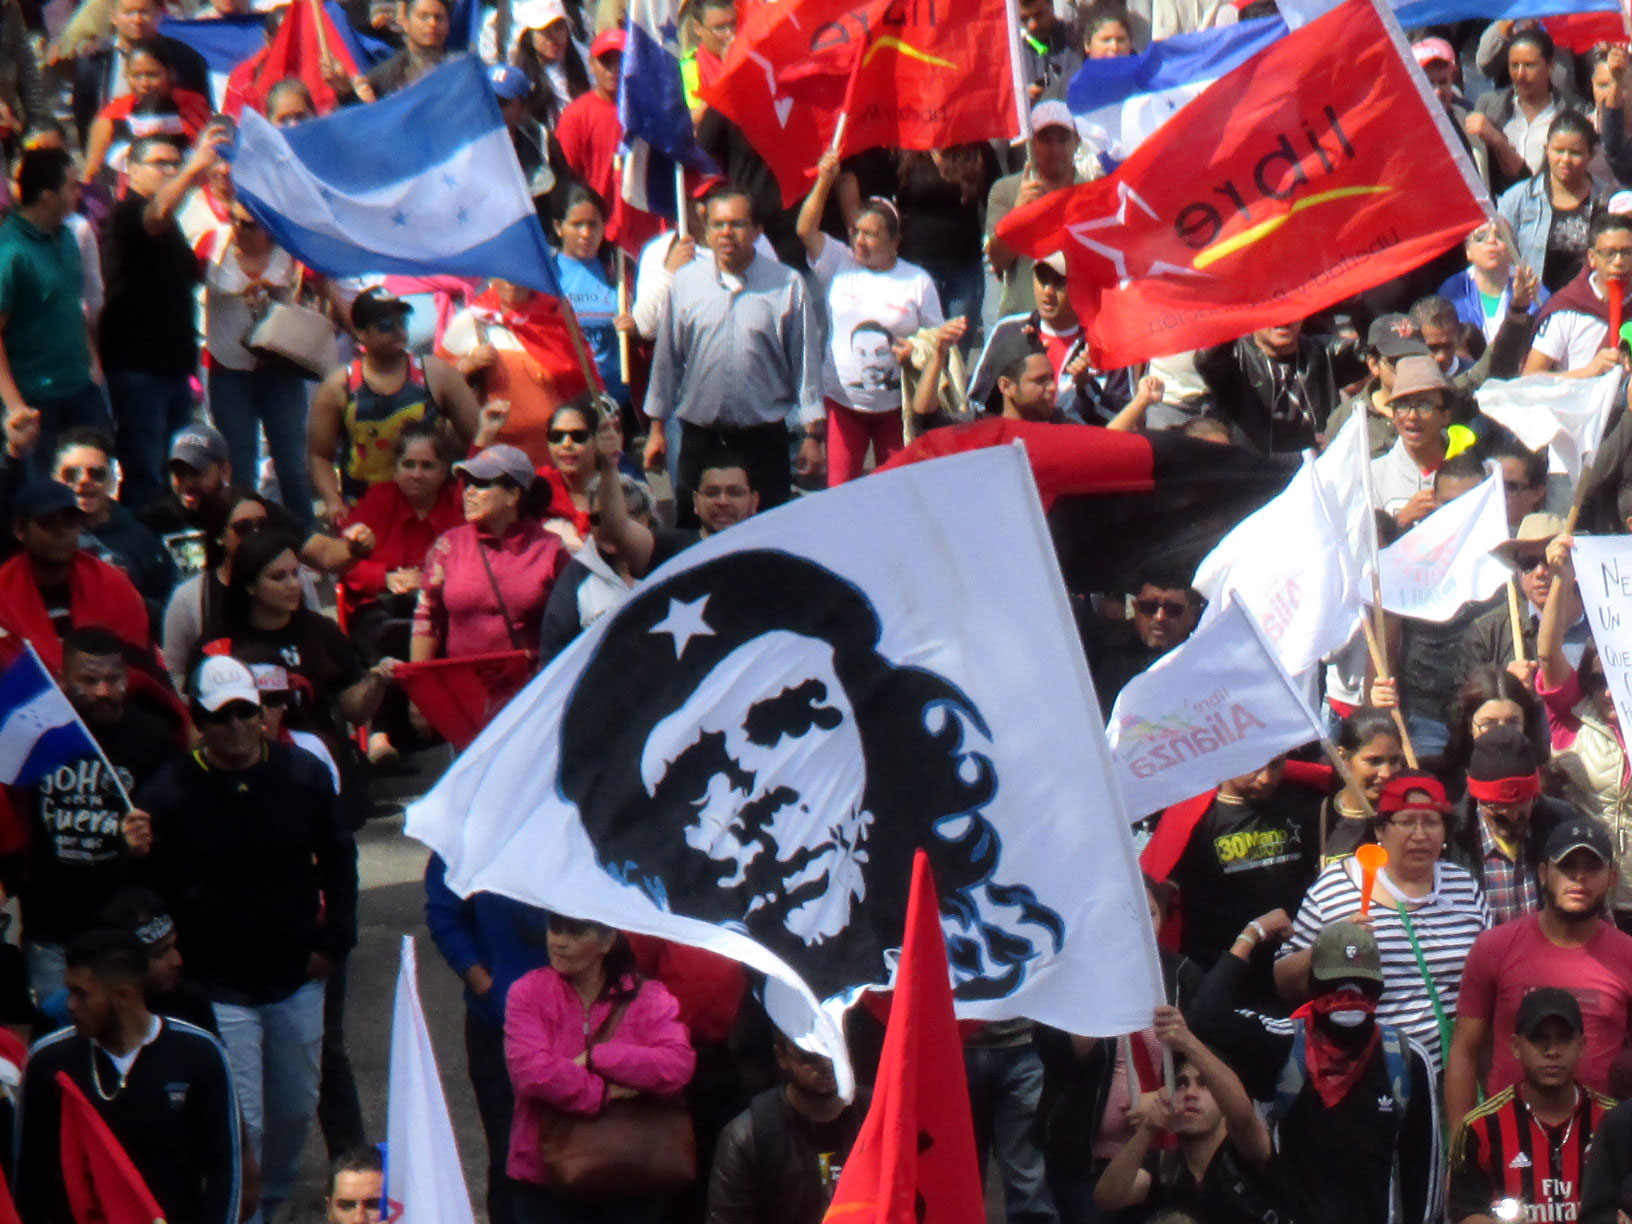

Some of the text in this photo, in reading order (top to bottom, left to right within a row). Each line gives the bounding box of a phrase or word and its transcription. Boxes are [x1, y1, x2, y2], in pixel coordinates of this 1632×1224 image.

[1599, 606, 1620, 630] UN
[1605, 645, 1632, 668] QUE
[1542, 1179, 1572, 1198] Fly
